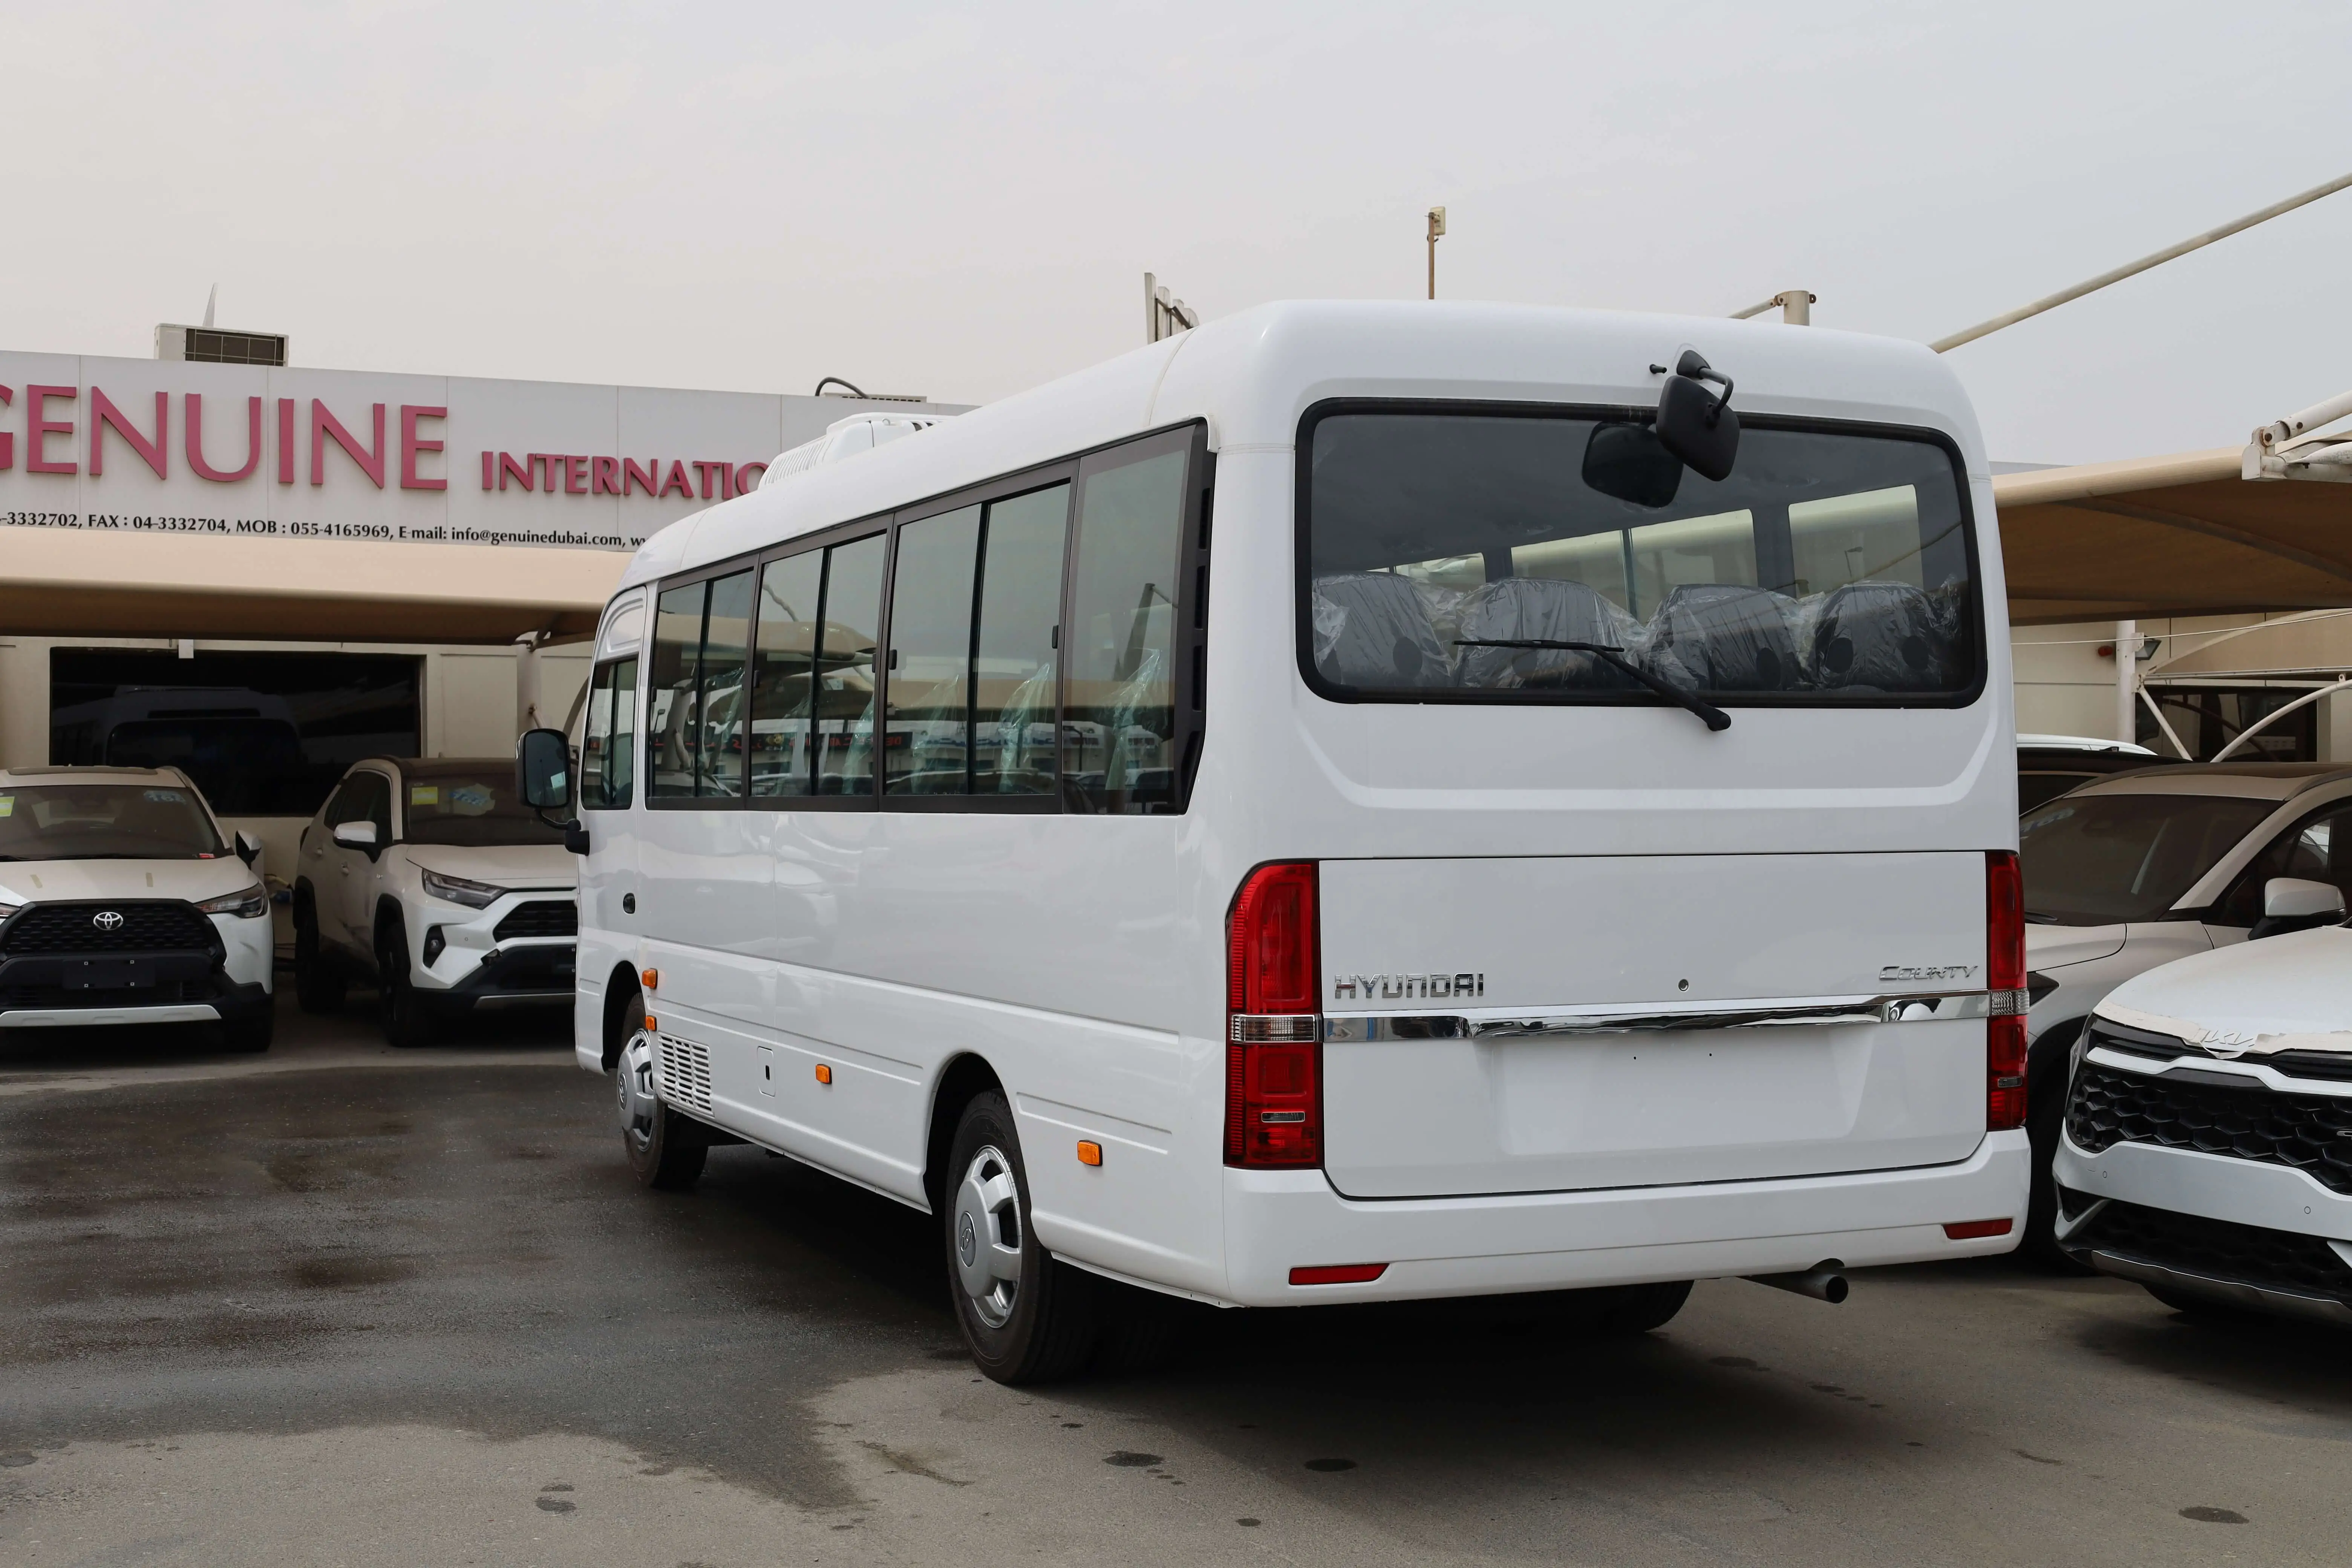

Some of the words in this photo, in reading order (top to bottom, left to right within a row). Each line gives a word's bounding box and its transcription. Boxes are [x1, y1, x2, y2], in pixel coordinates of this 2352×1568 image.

[0, 384, 447, 490] ENUINE
[88, 514, 119, 528] FAX
[133, 516, 231, 534] 04-3332704,
[236, 519, 277, 533] MOB
[291, 522, 394, 541] 055-4165969,
[399, 525, 447, 540] E-mail:
[452, 527, 626, 548] info@genuinedubai.com,
[1335, 972, 1484, 999] HYUNDAI
